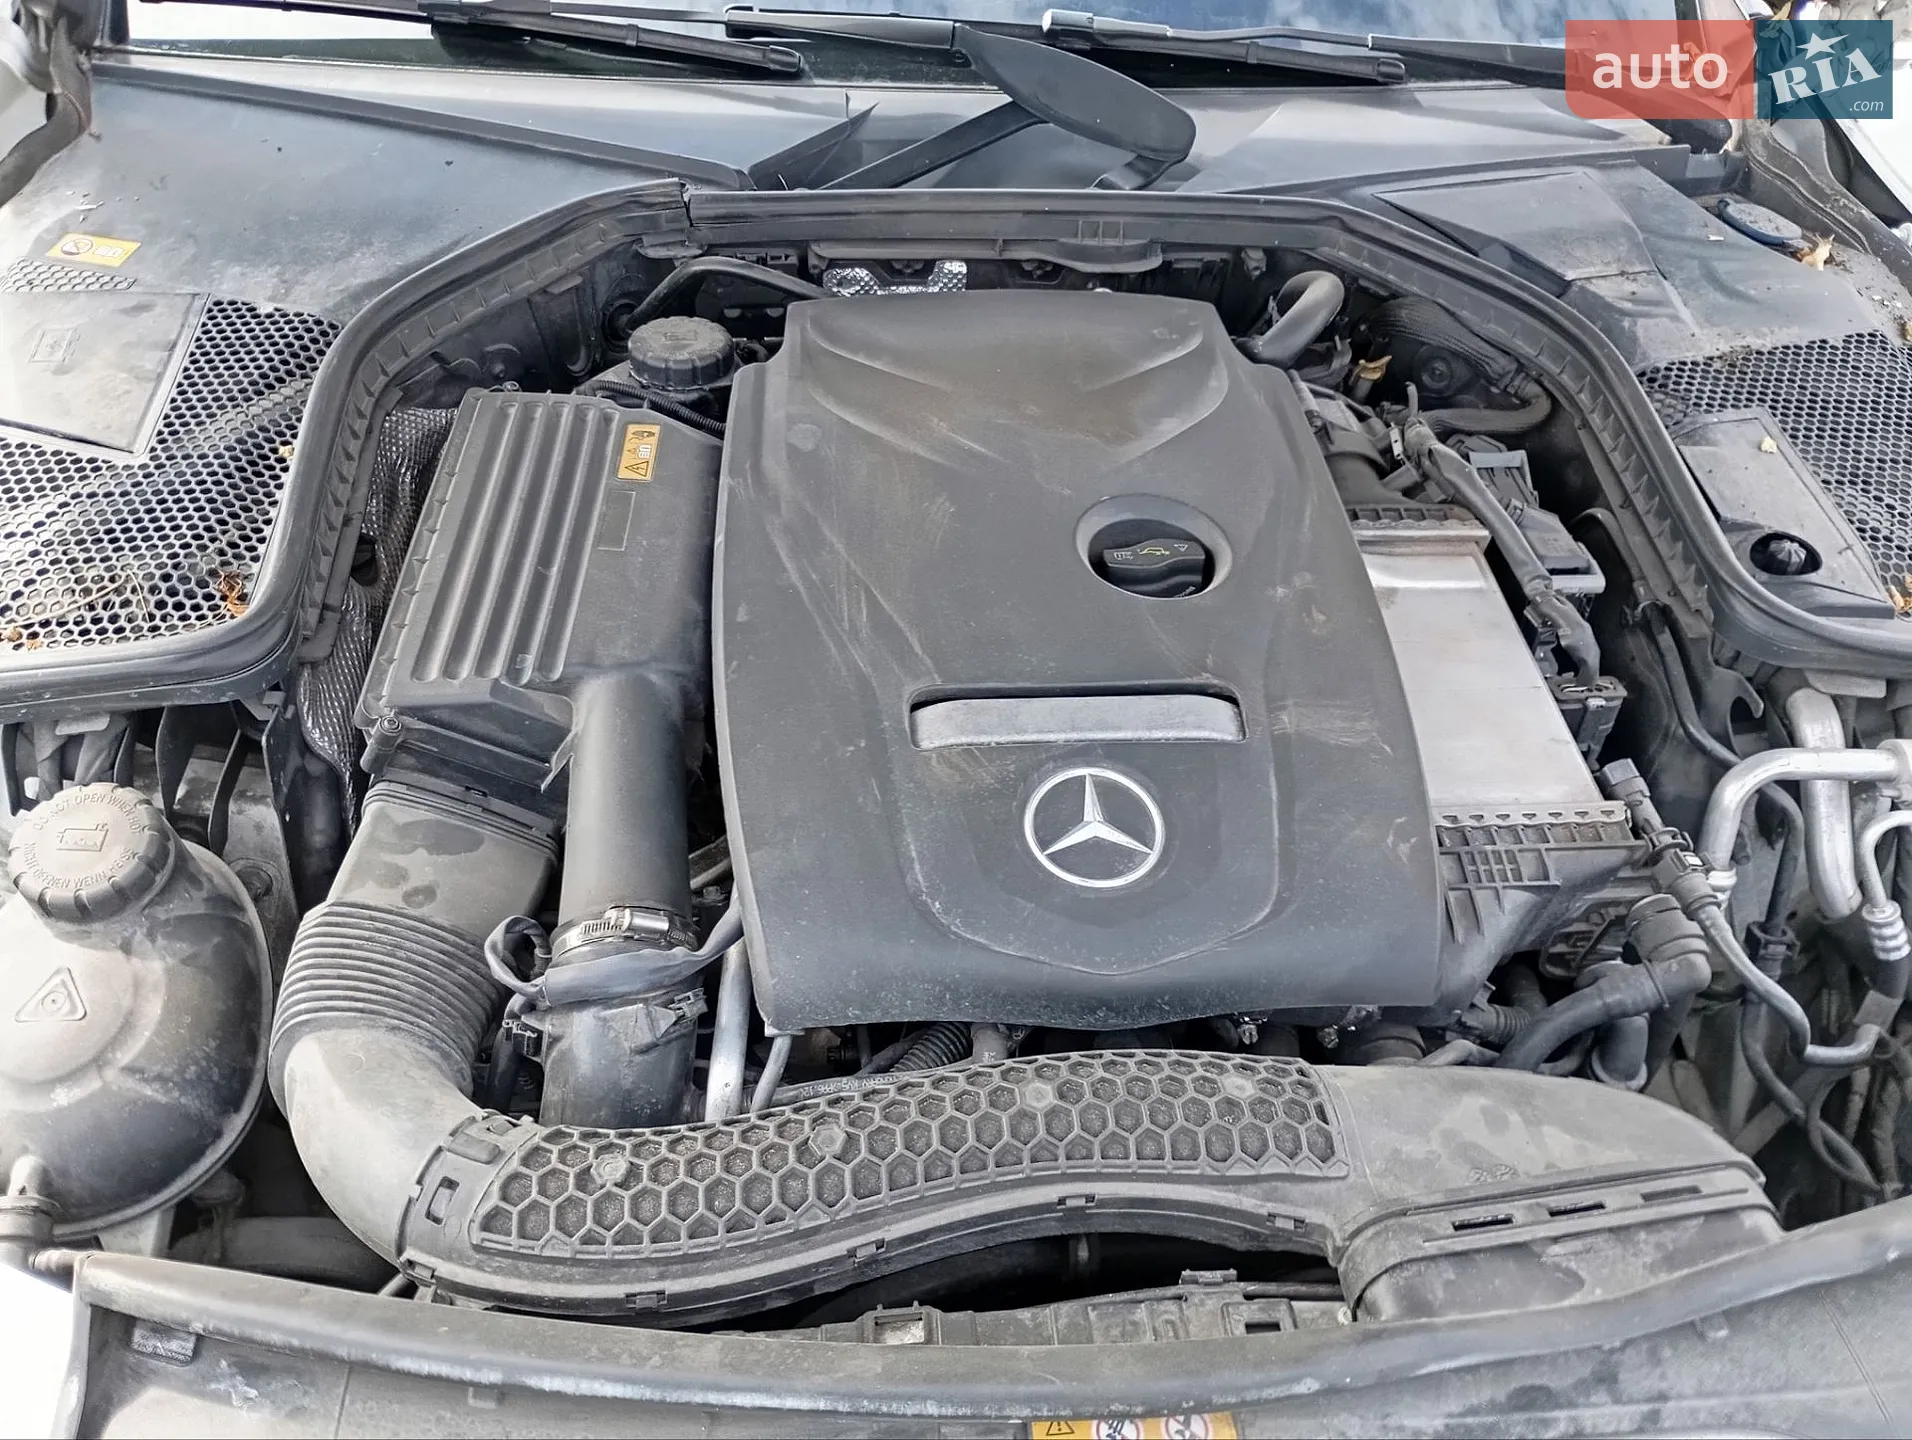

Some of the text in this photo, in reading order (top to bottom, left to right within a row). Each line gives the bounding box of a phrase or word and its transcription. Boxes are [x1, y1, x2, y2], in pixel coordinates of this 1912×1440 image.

[75, 793, 105, 805] OPEN
[108, 795, 136, 818] WHEN
[74, 871, 106, 889] WENN
